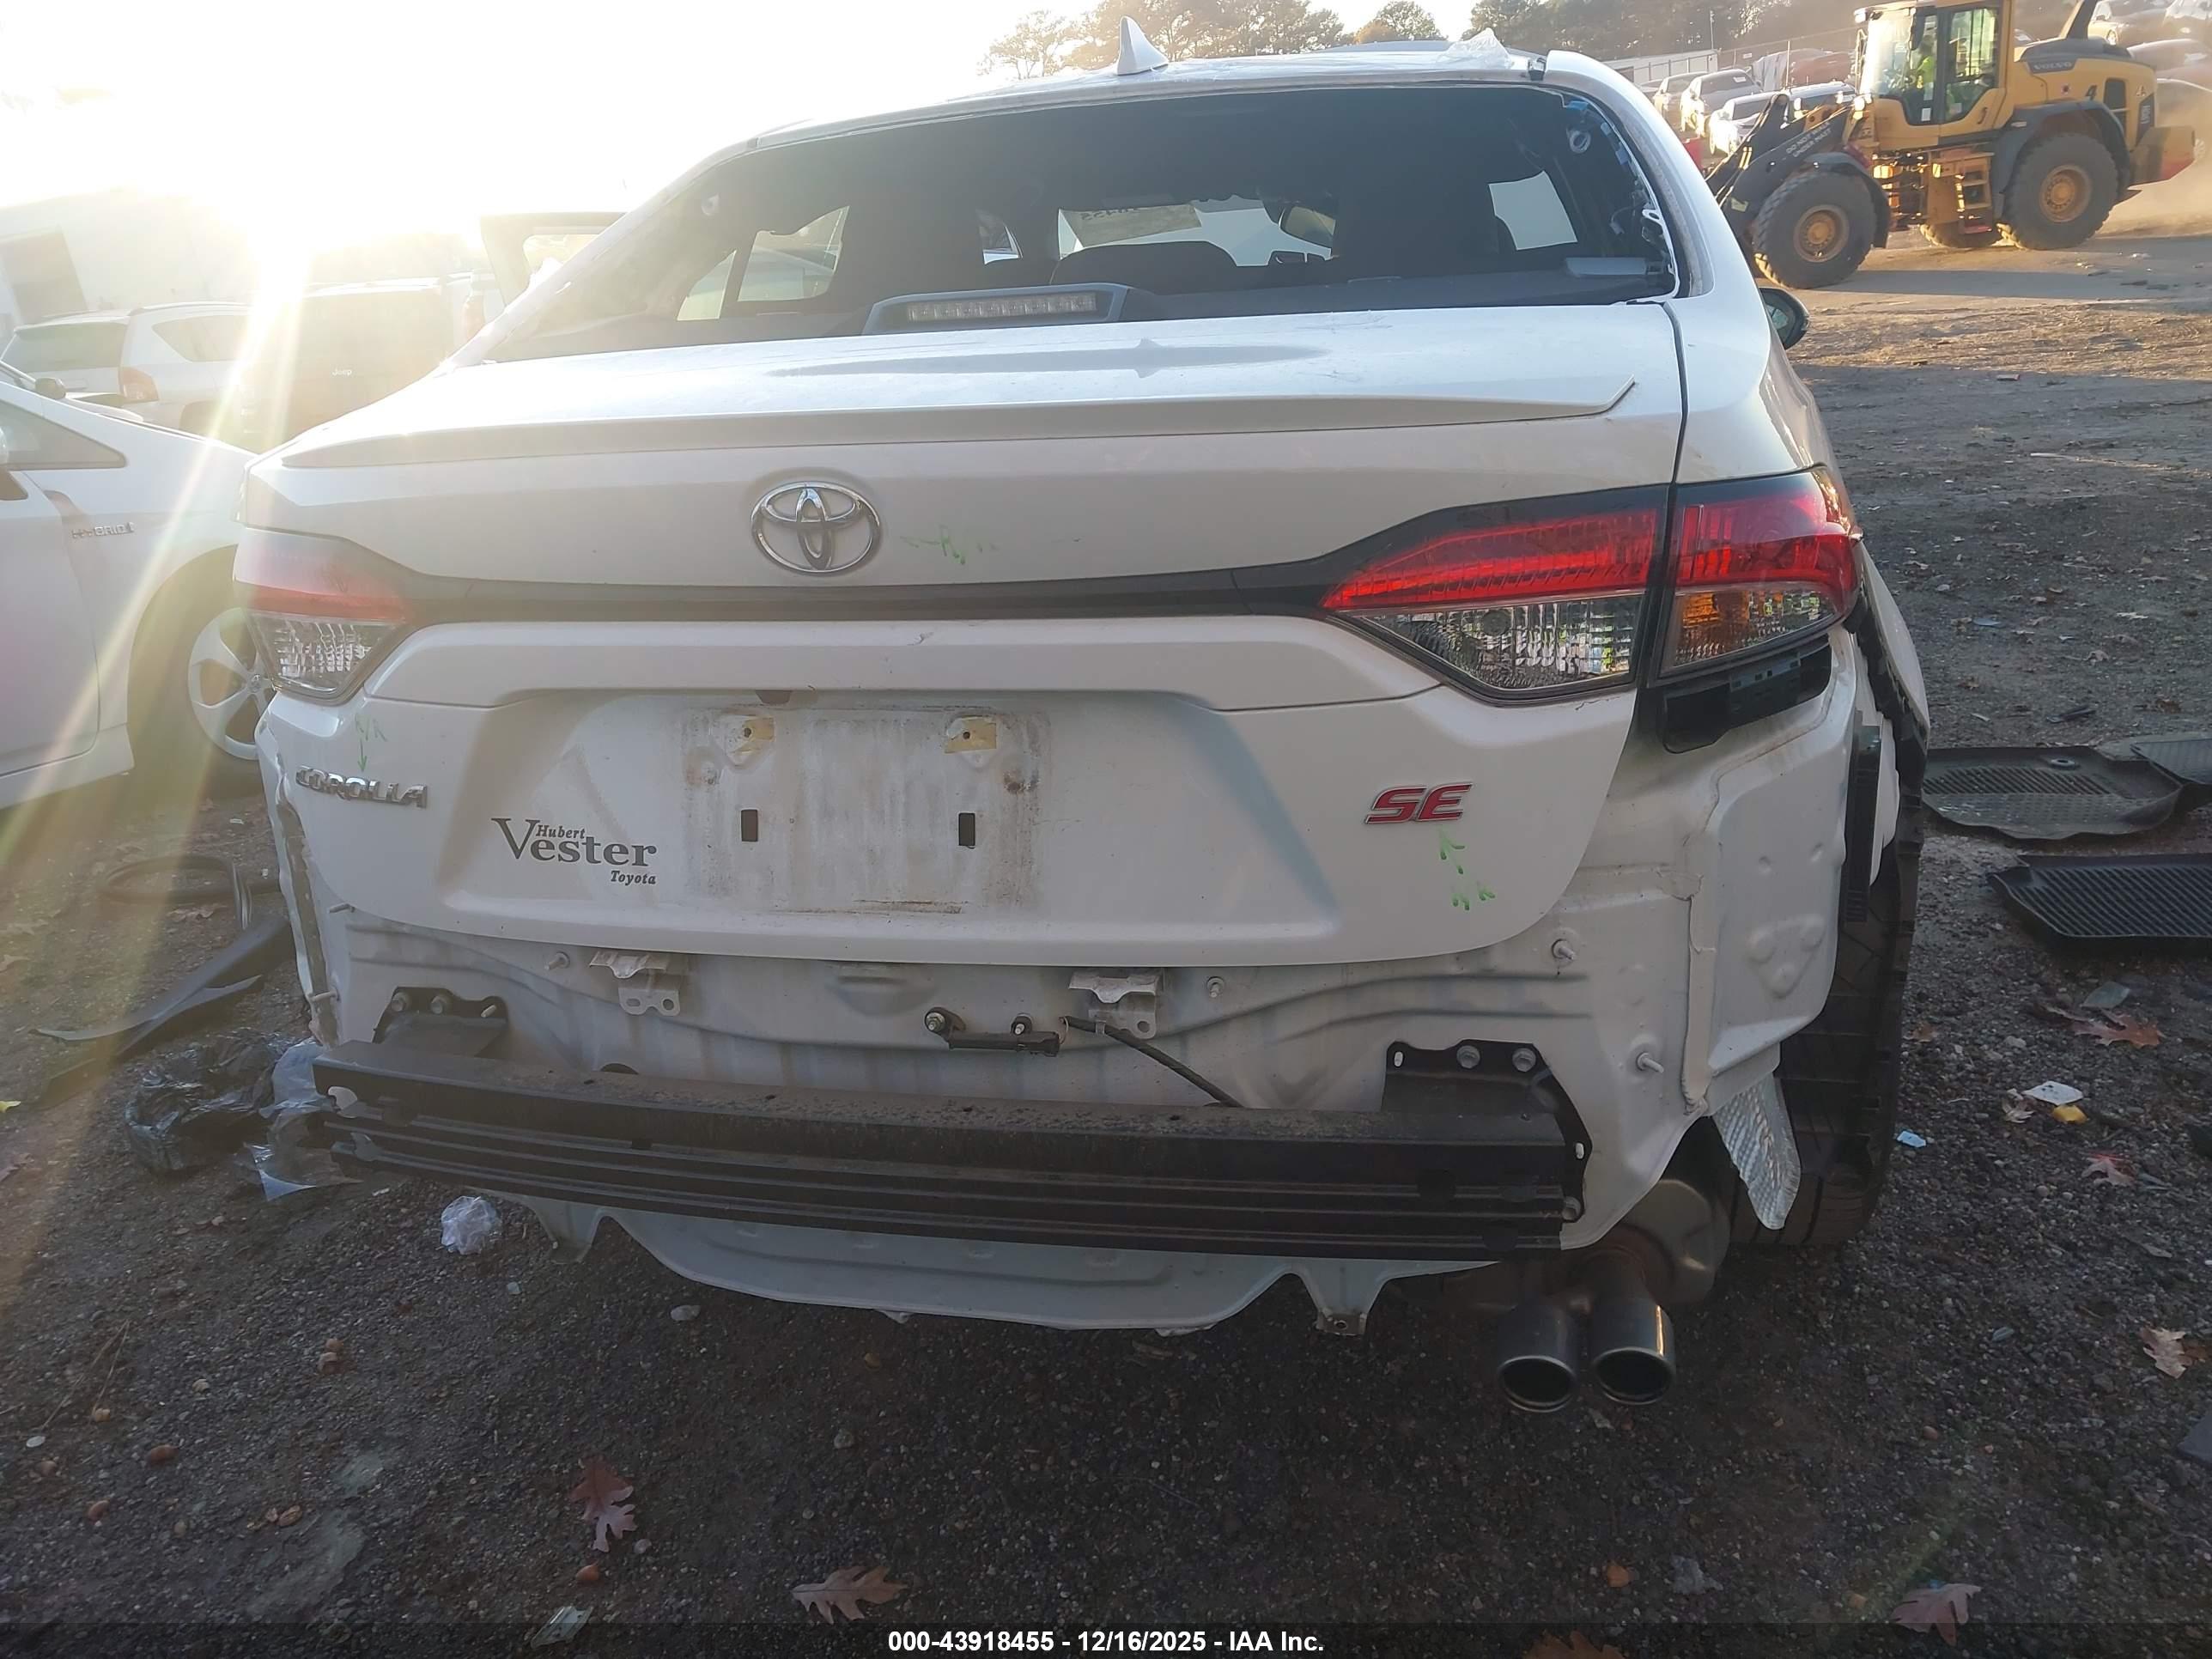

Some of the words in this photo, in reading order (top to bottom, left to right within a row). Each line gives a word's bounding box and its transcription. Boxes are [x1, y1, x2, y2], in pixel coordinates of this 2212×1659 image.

[2033, 61, 2072, 70] VOLVO
[332, 368, 352, 377] Jeep
[1364, 782, 1473, 824] SE
[535, 824, 586, 839] Hubert
[491, 817, 657, 866] Vester
[611, 870, 656, 885] Toyota
